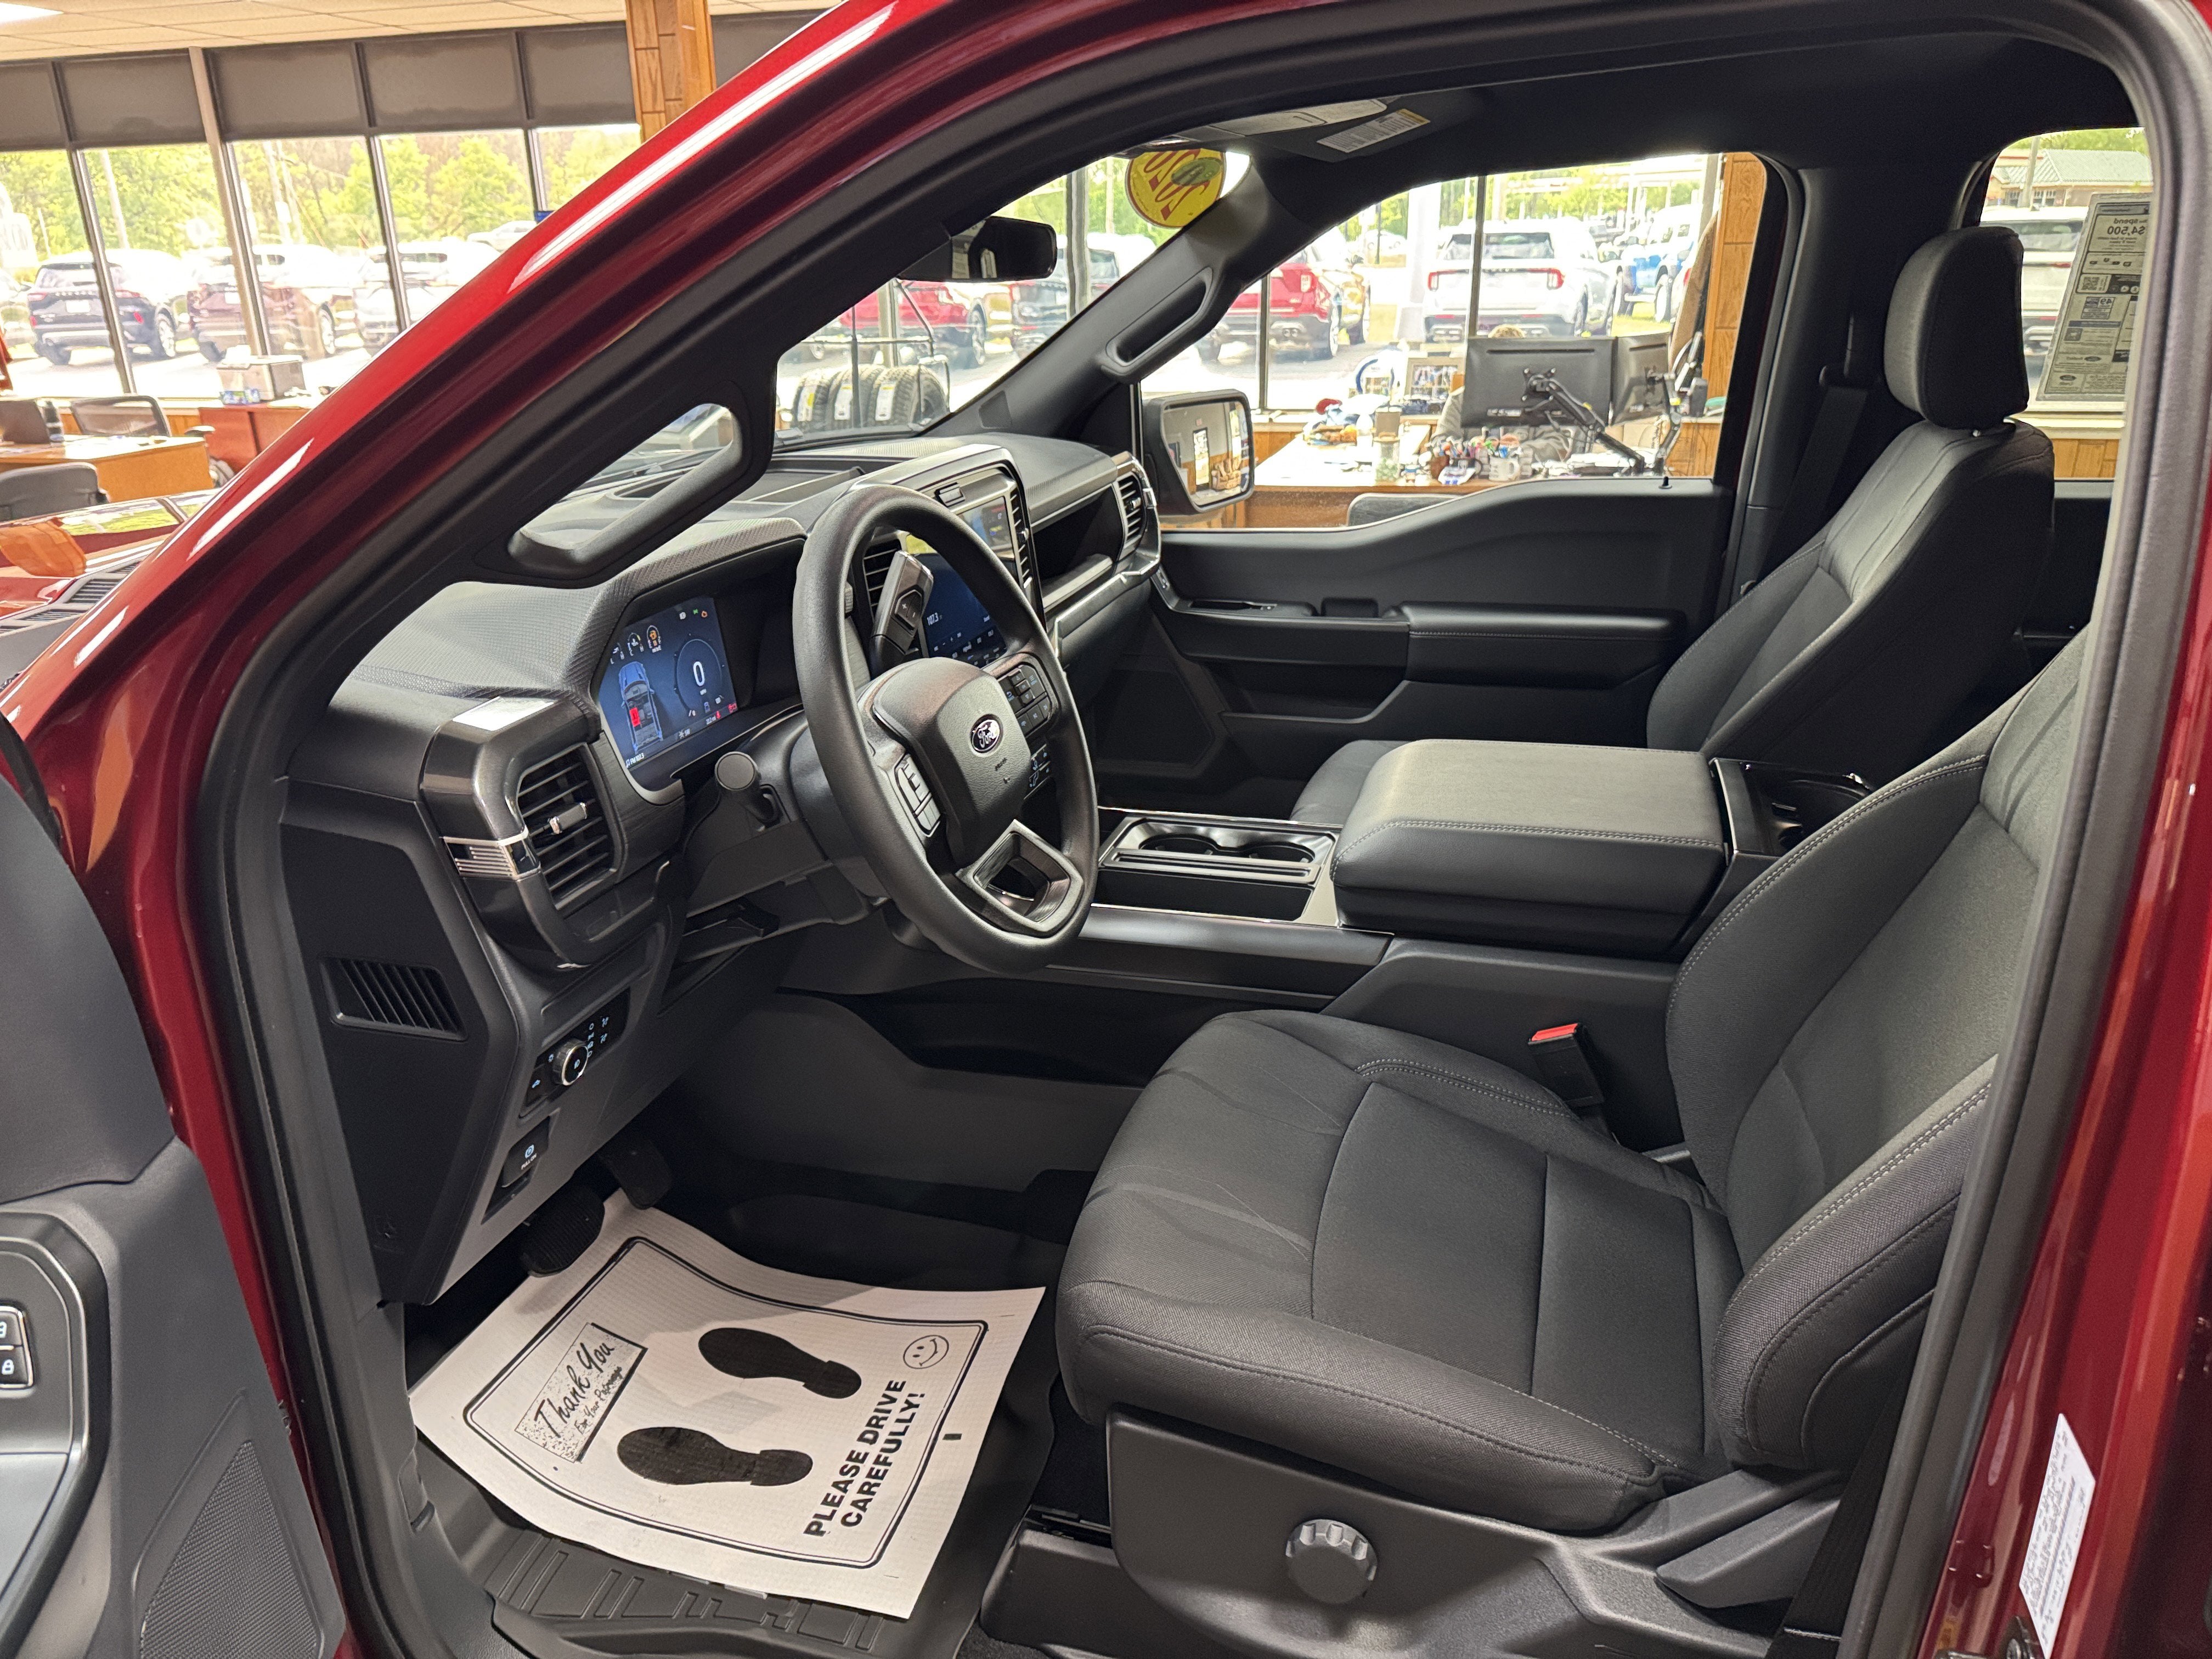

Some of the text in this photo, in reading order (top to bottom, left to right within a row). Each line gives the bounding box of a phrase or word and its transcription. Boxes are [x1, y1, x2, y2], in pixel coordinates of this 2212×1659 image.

[693, 661, 705, 686] 0
[521, 1153, 537, 1170] PULL ON
[534, 1342, 615, 1438] Thank You
[574, 1418, 589, 1435] For
[583, 1401, 600, 1418] Your
[803, 1380, 906, 1537] PLEASE DRIVE
[840, 1393, 925, 1527] CAREFULLY!
